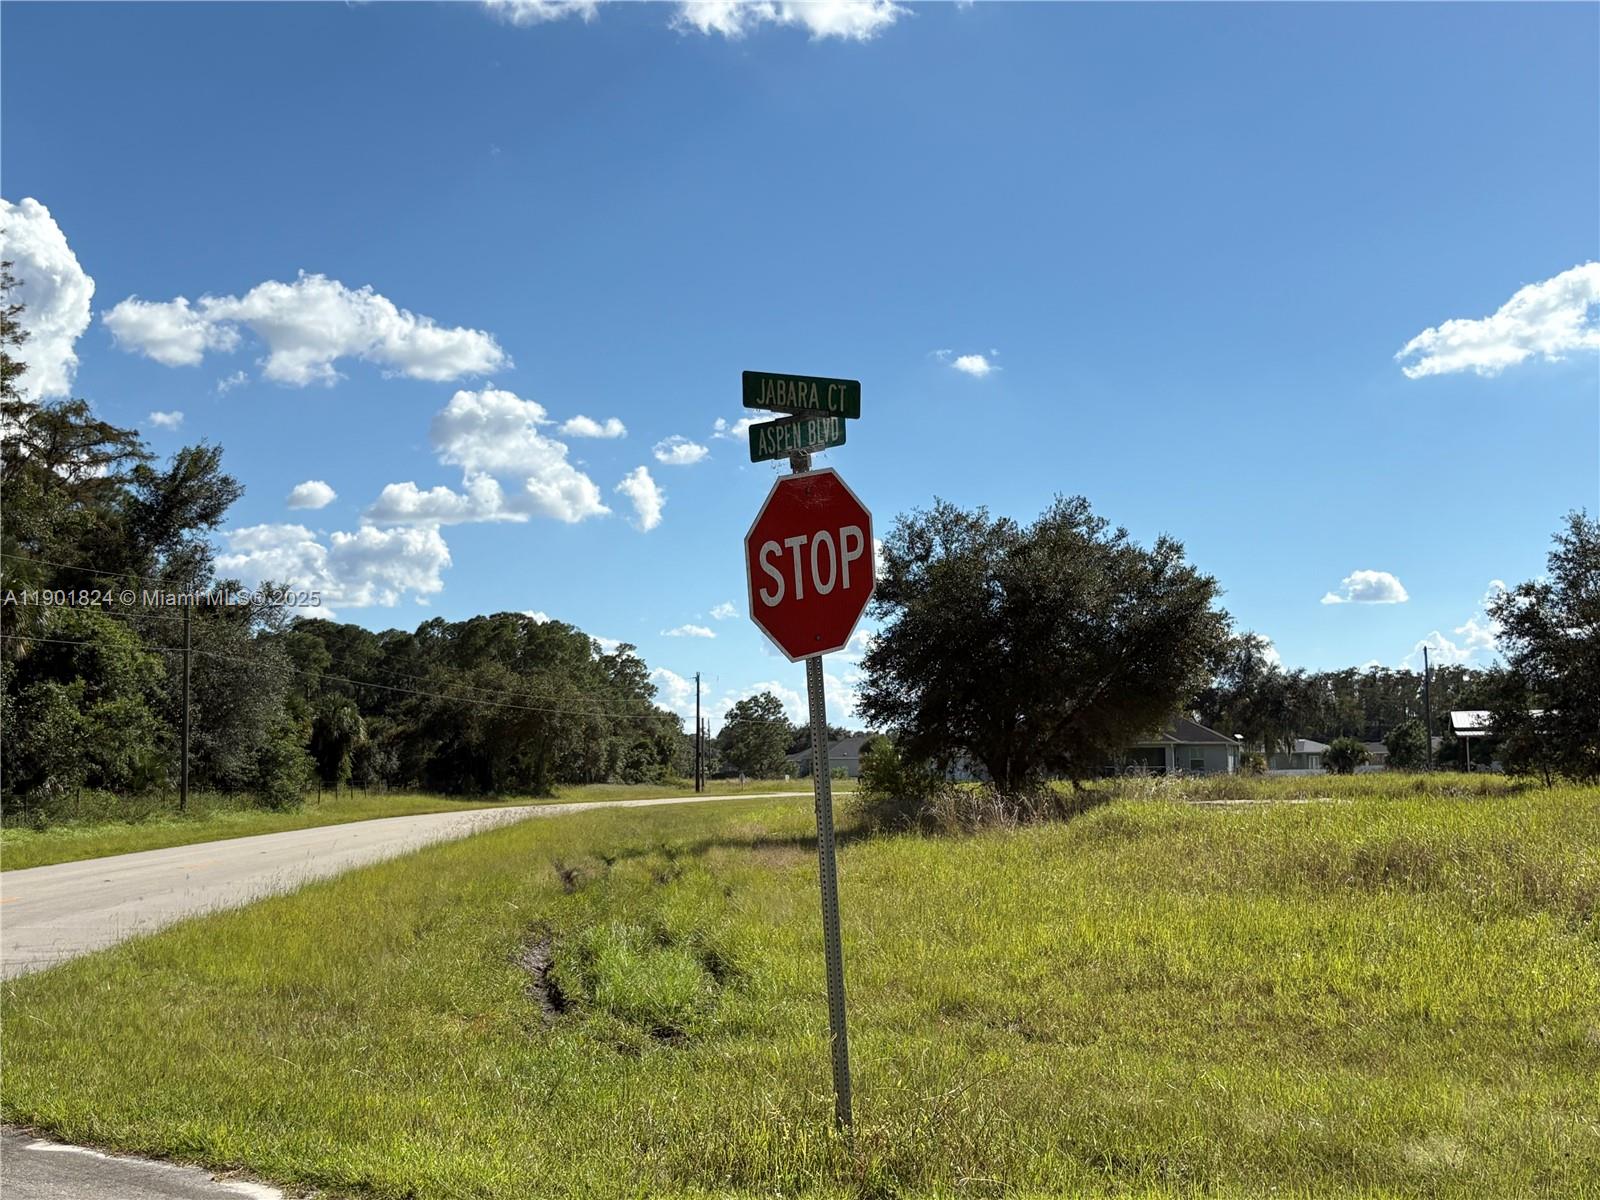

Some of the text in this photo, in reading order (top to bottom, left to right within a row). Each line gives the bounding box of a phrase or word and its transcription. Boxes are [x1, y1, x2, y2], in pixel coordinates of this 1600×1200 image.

[756, 378, 847, 412] JABARA CT
[758, 416, 840, 456] ASPEN BLVD
[759, 525, 865, 608] STOP
